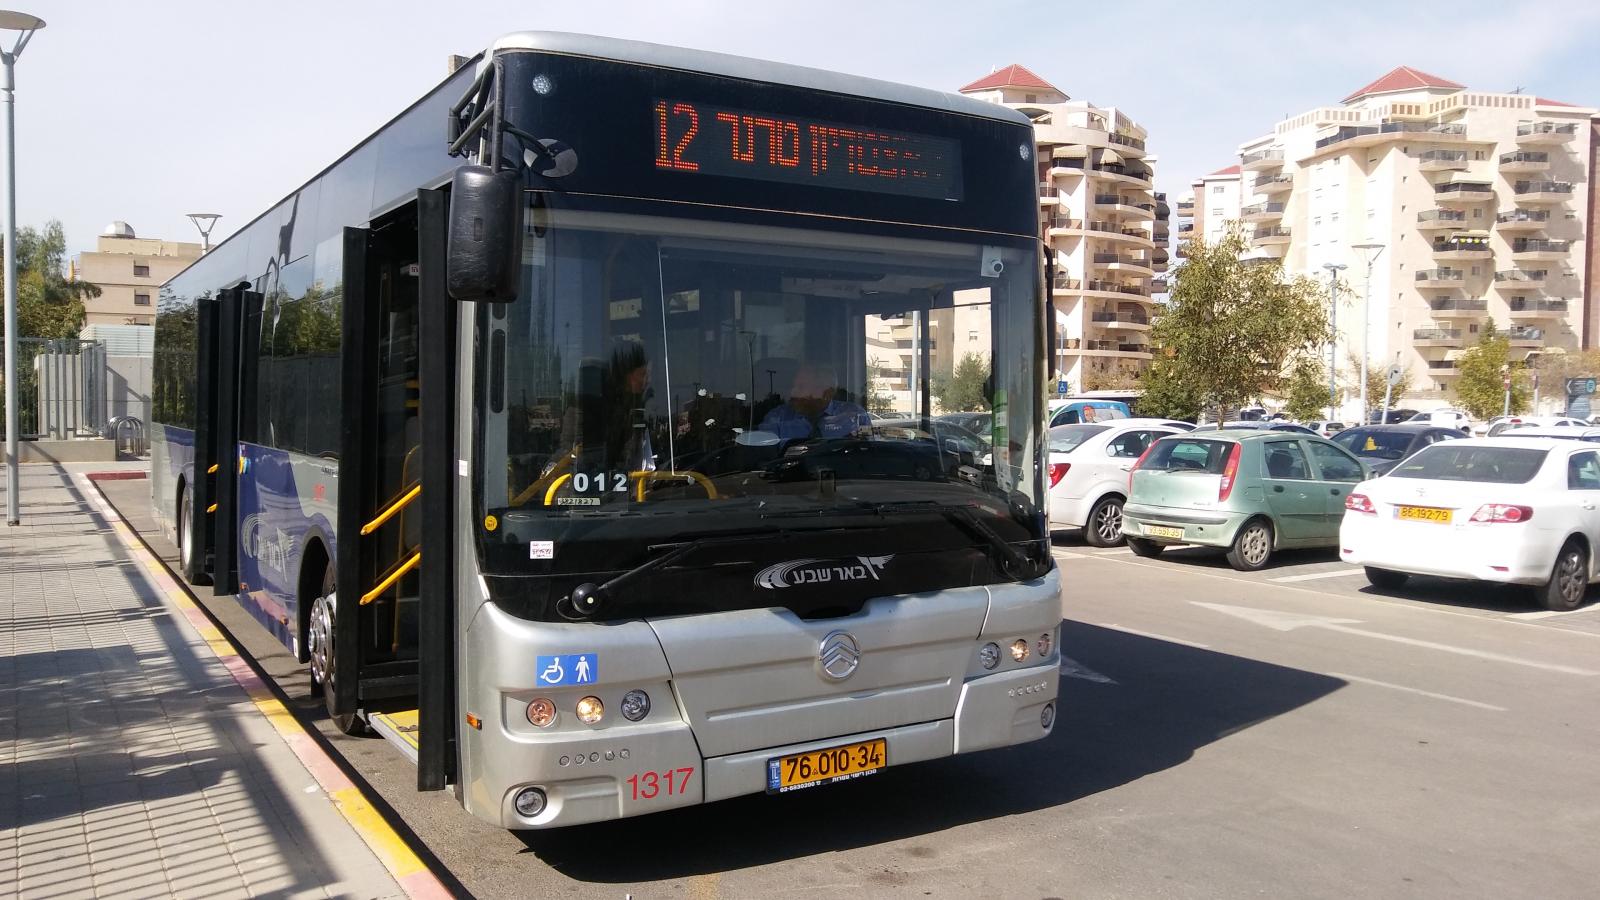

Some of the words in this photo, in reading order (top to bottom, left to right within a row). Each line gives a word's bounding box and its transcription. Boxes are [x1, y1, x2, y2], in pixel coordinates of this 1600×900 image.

[655, 100, 699, 170] 12
[573, 472, 628, 492] 012
[793, 567, 831, 584] שבע
[832, 565, 868, 581] באר
[626, 767, 695, 801] 1317
